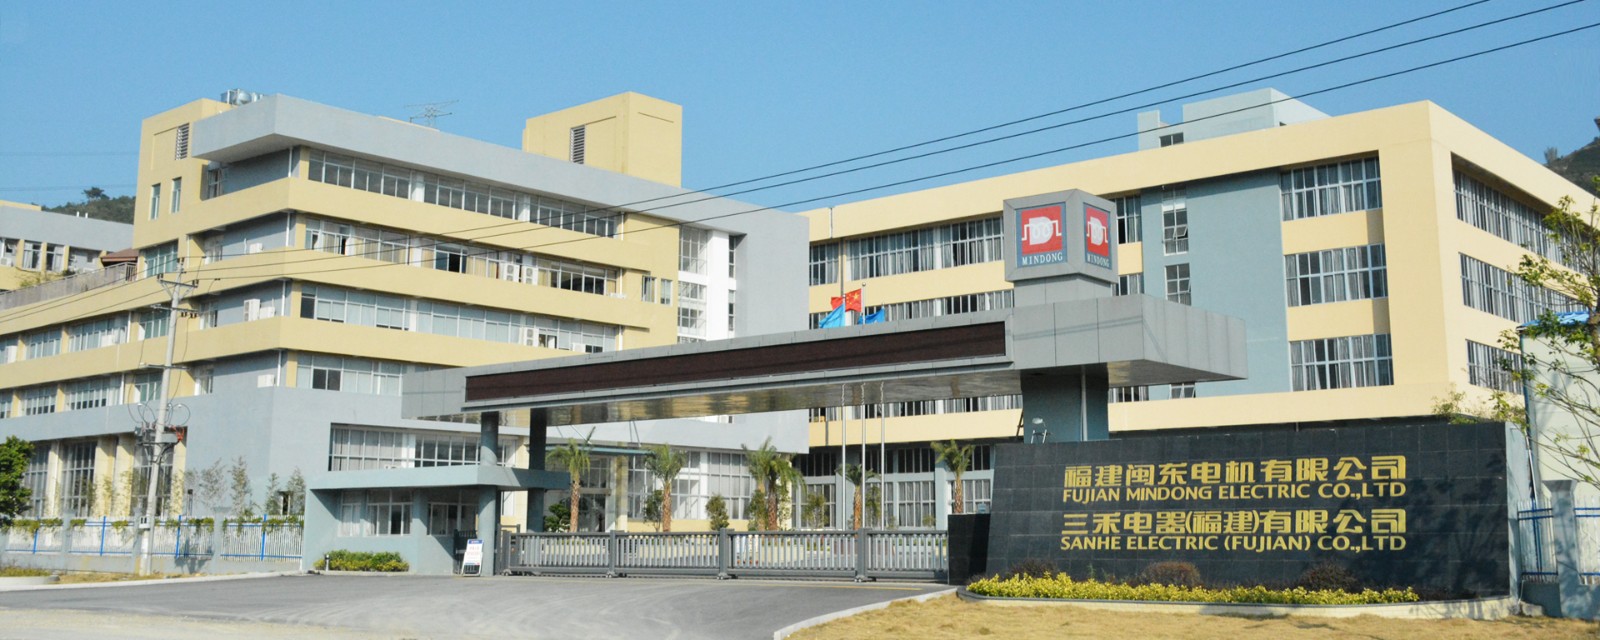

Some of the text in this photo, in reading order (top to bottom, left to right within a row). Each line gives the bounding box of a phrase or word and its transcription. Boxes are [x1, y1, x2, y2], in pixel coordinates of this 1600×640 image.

[1022, 252, 1063, 266] MINDONG
[1087, 253, 1110, 268] MINDONG
[1064, 455, 1406, 488] 福建闽东电机有限公司
[1063, 482, 1406, 504] FUJIAN MINDONG ELECTRIC CO.,LTD
[1061, 509, 1406, 534] 三禾电器(福建)有限公司
[1060, 535, 1406, 553] SANHE ELECTRIC (FUJIAN) CO.,LTD
